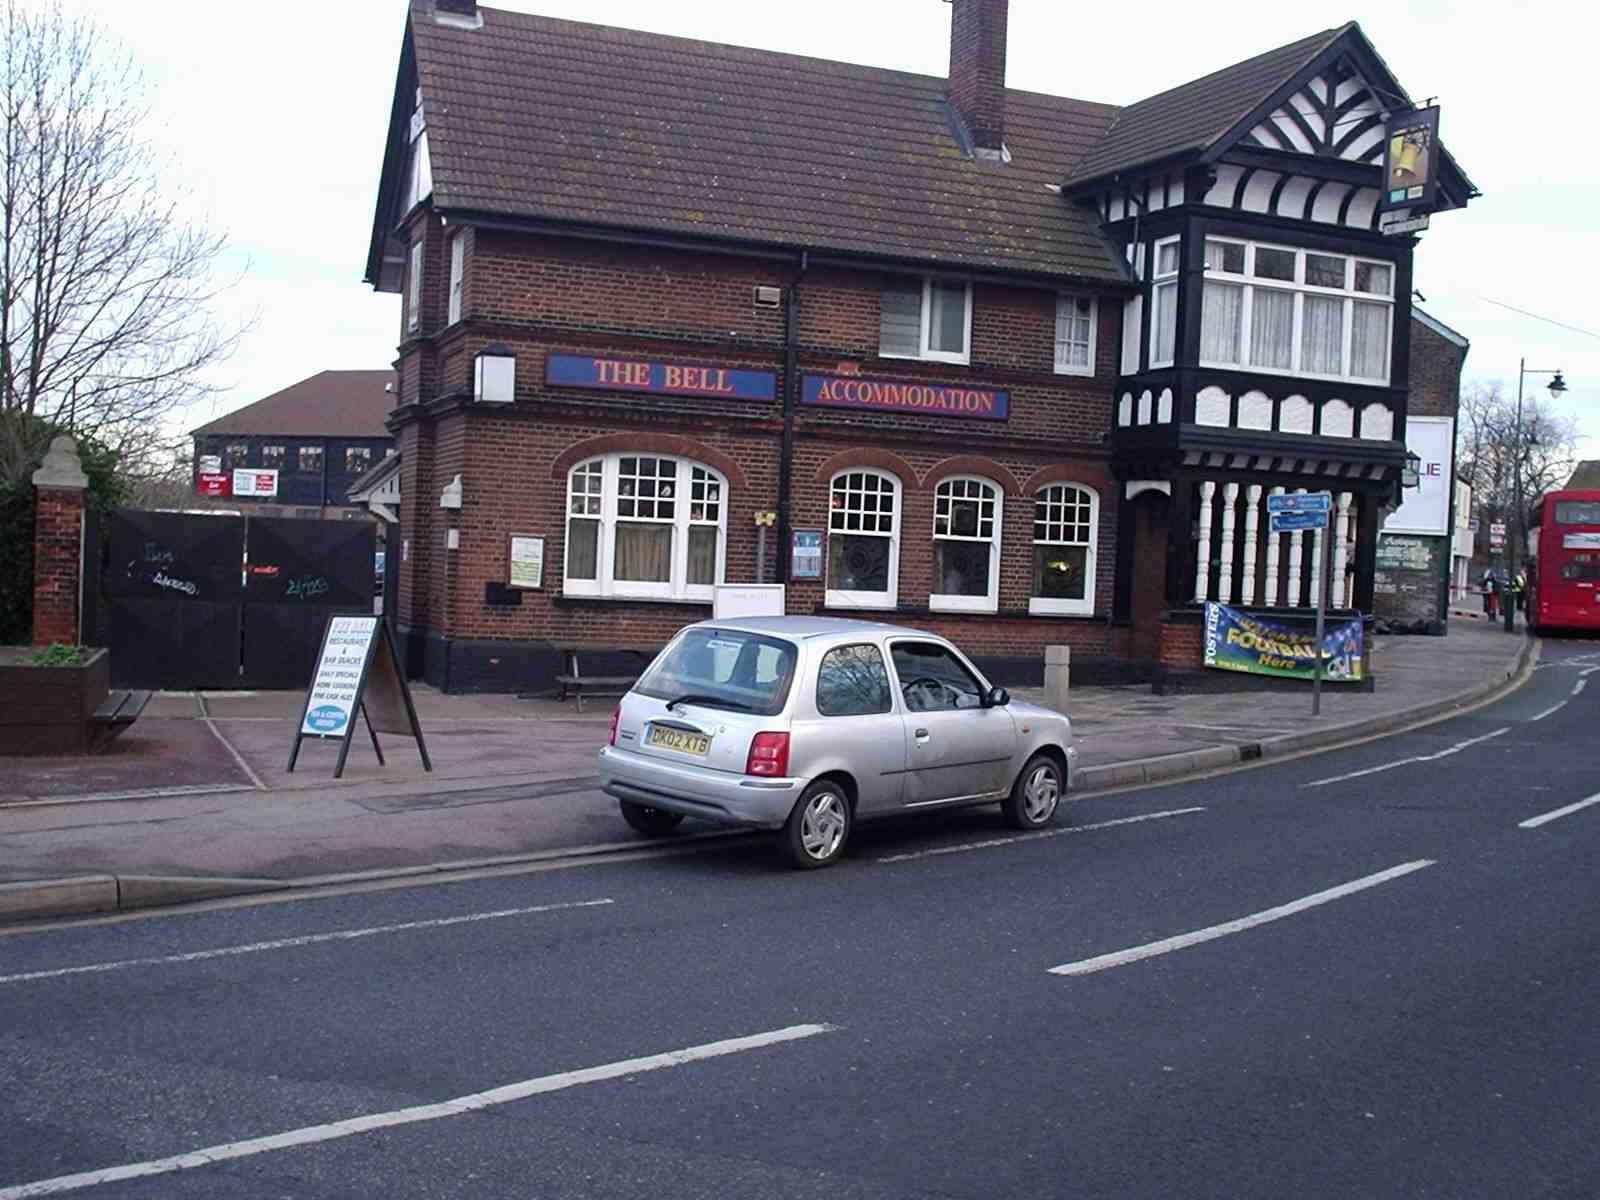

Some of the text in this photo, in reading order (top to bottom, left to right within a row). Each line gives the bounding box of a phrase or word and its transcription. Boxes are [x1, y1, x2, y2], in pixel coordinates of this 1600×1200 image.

[593, 359, 735, 393] THE BELL
[818, 379, 993, 412] ACCOMMODATION
[1227, 626, 1331, 659] FOOTBALL
[323, 656, 337, 665] BAR
[1258, 652, 1297, 669] Here
